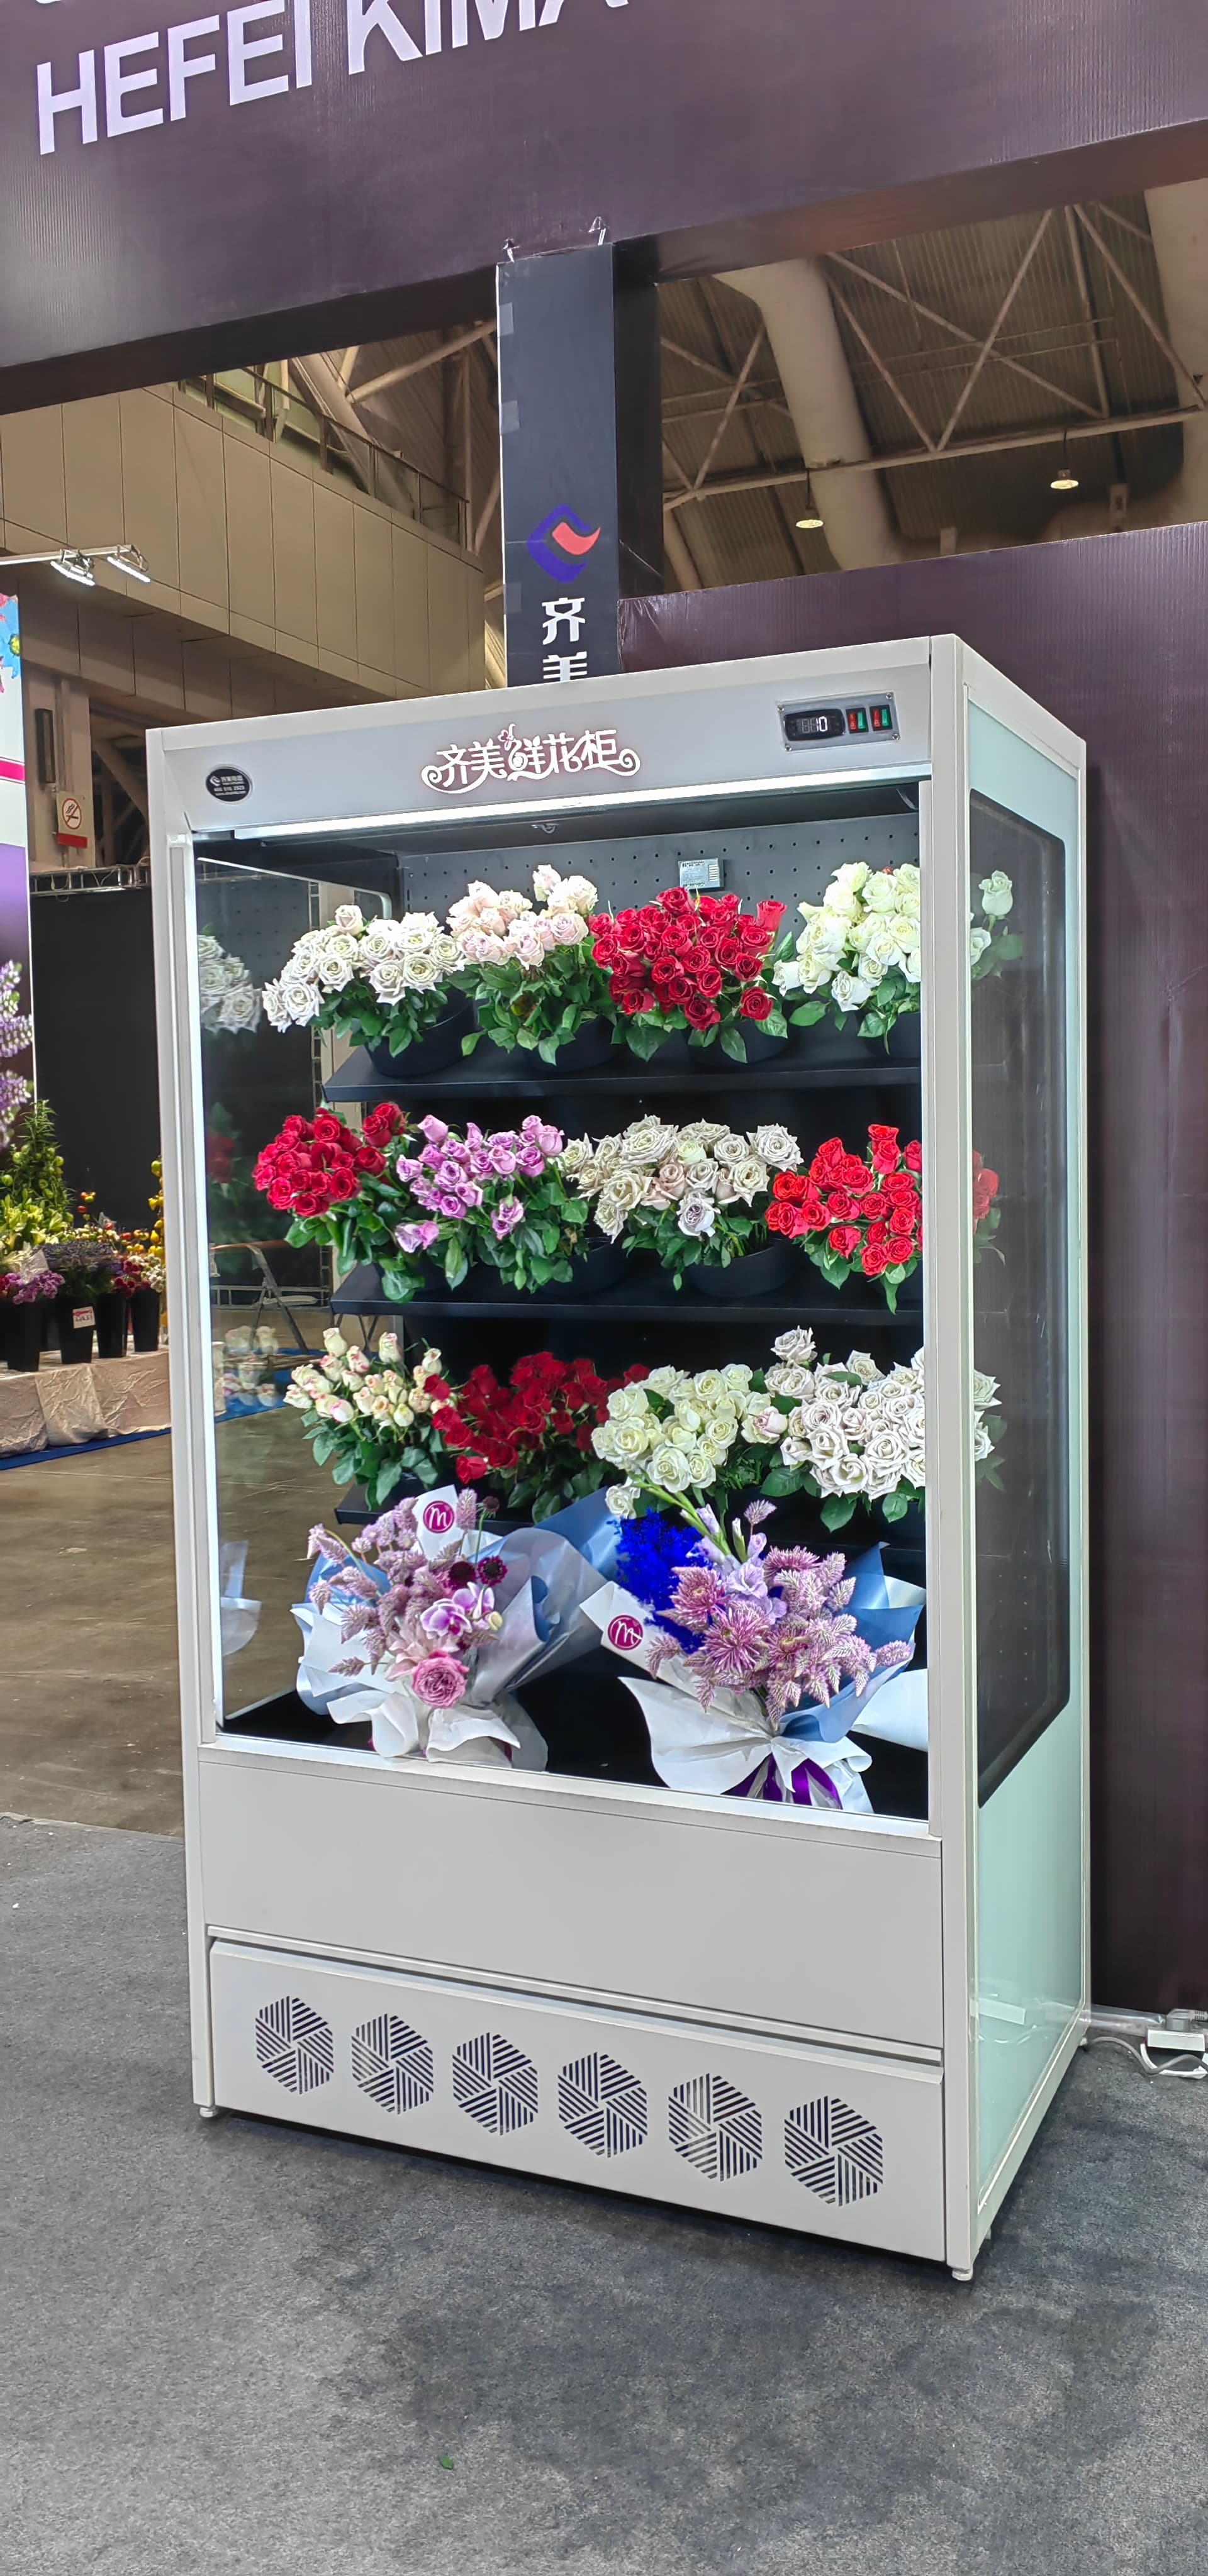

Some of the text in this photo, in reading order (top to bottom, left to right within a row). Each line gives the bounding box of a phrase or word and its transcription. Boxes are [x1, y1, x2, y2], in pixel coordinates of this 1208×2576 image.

[36, 0, 628, 155] HEFEI KI
[421, 723, 640, 794] 齐美鲜花柜
